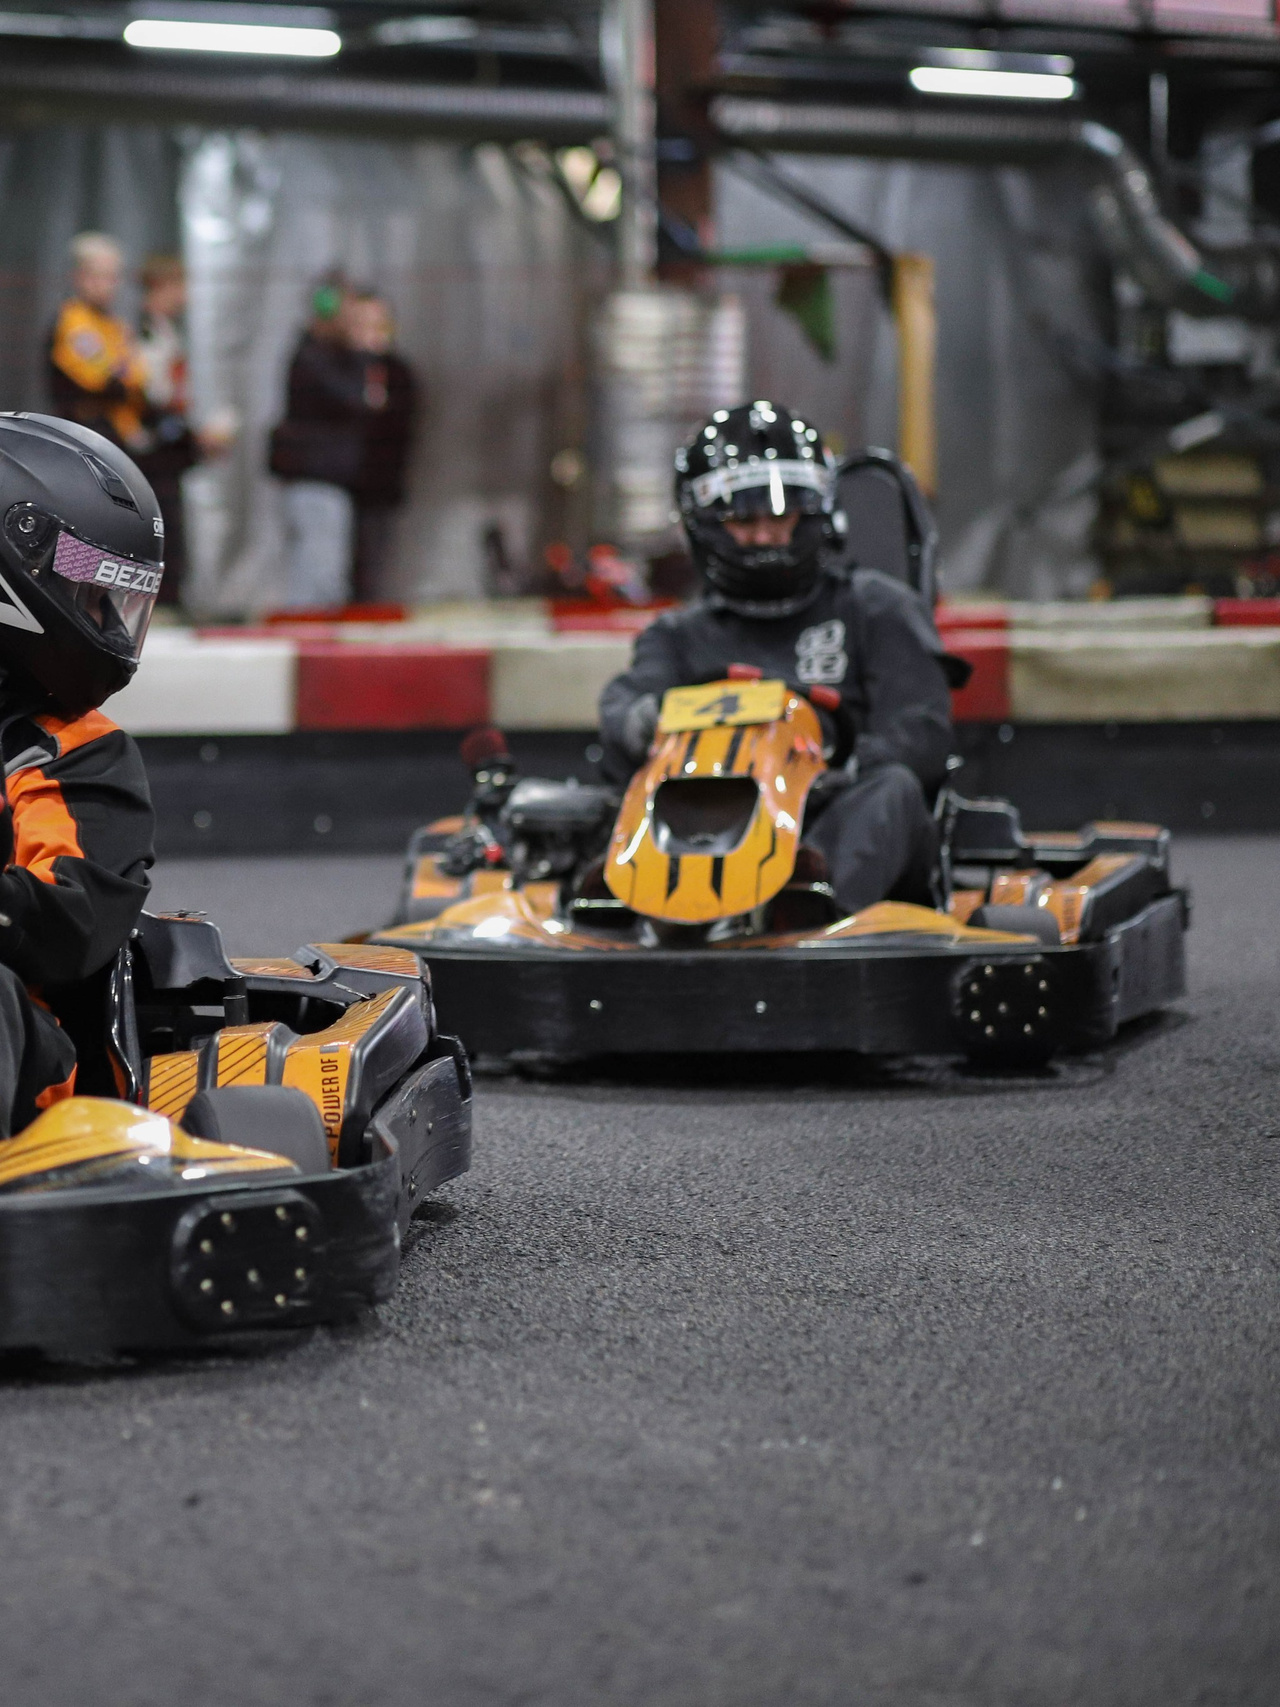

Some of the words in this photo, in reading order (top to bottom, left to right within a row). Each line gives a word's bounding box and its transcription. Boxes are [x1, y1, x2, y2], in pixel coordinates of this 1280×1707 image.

[694, 692, 742, 722] 4
[320, 1058, 339, 1073] OF
[321, 1076, 342, 1139] POWER
